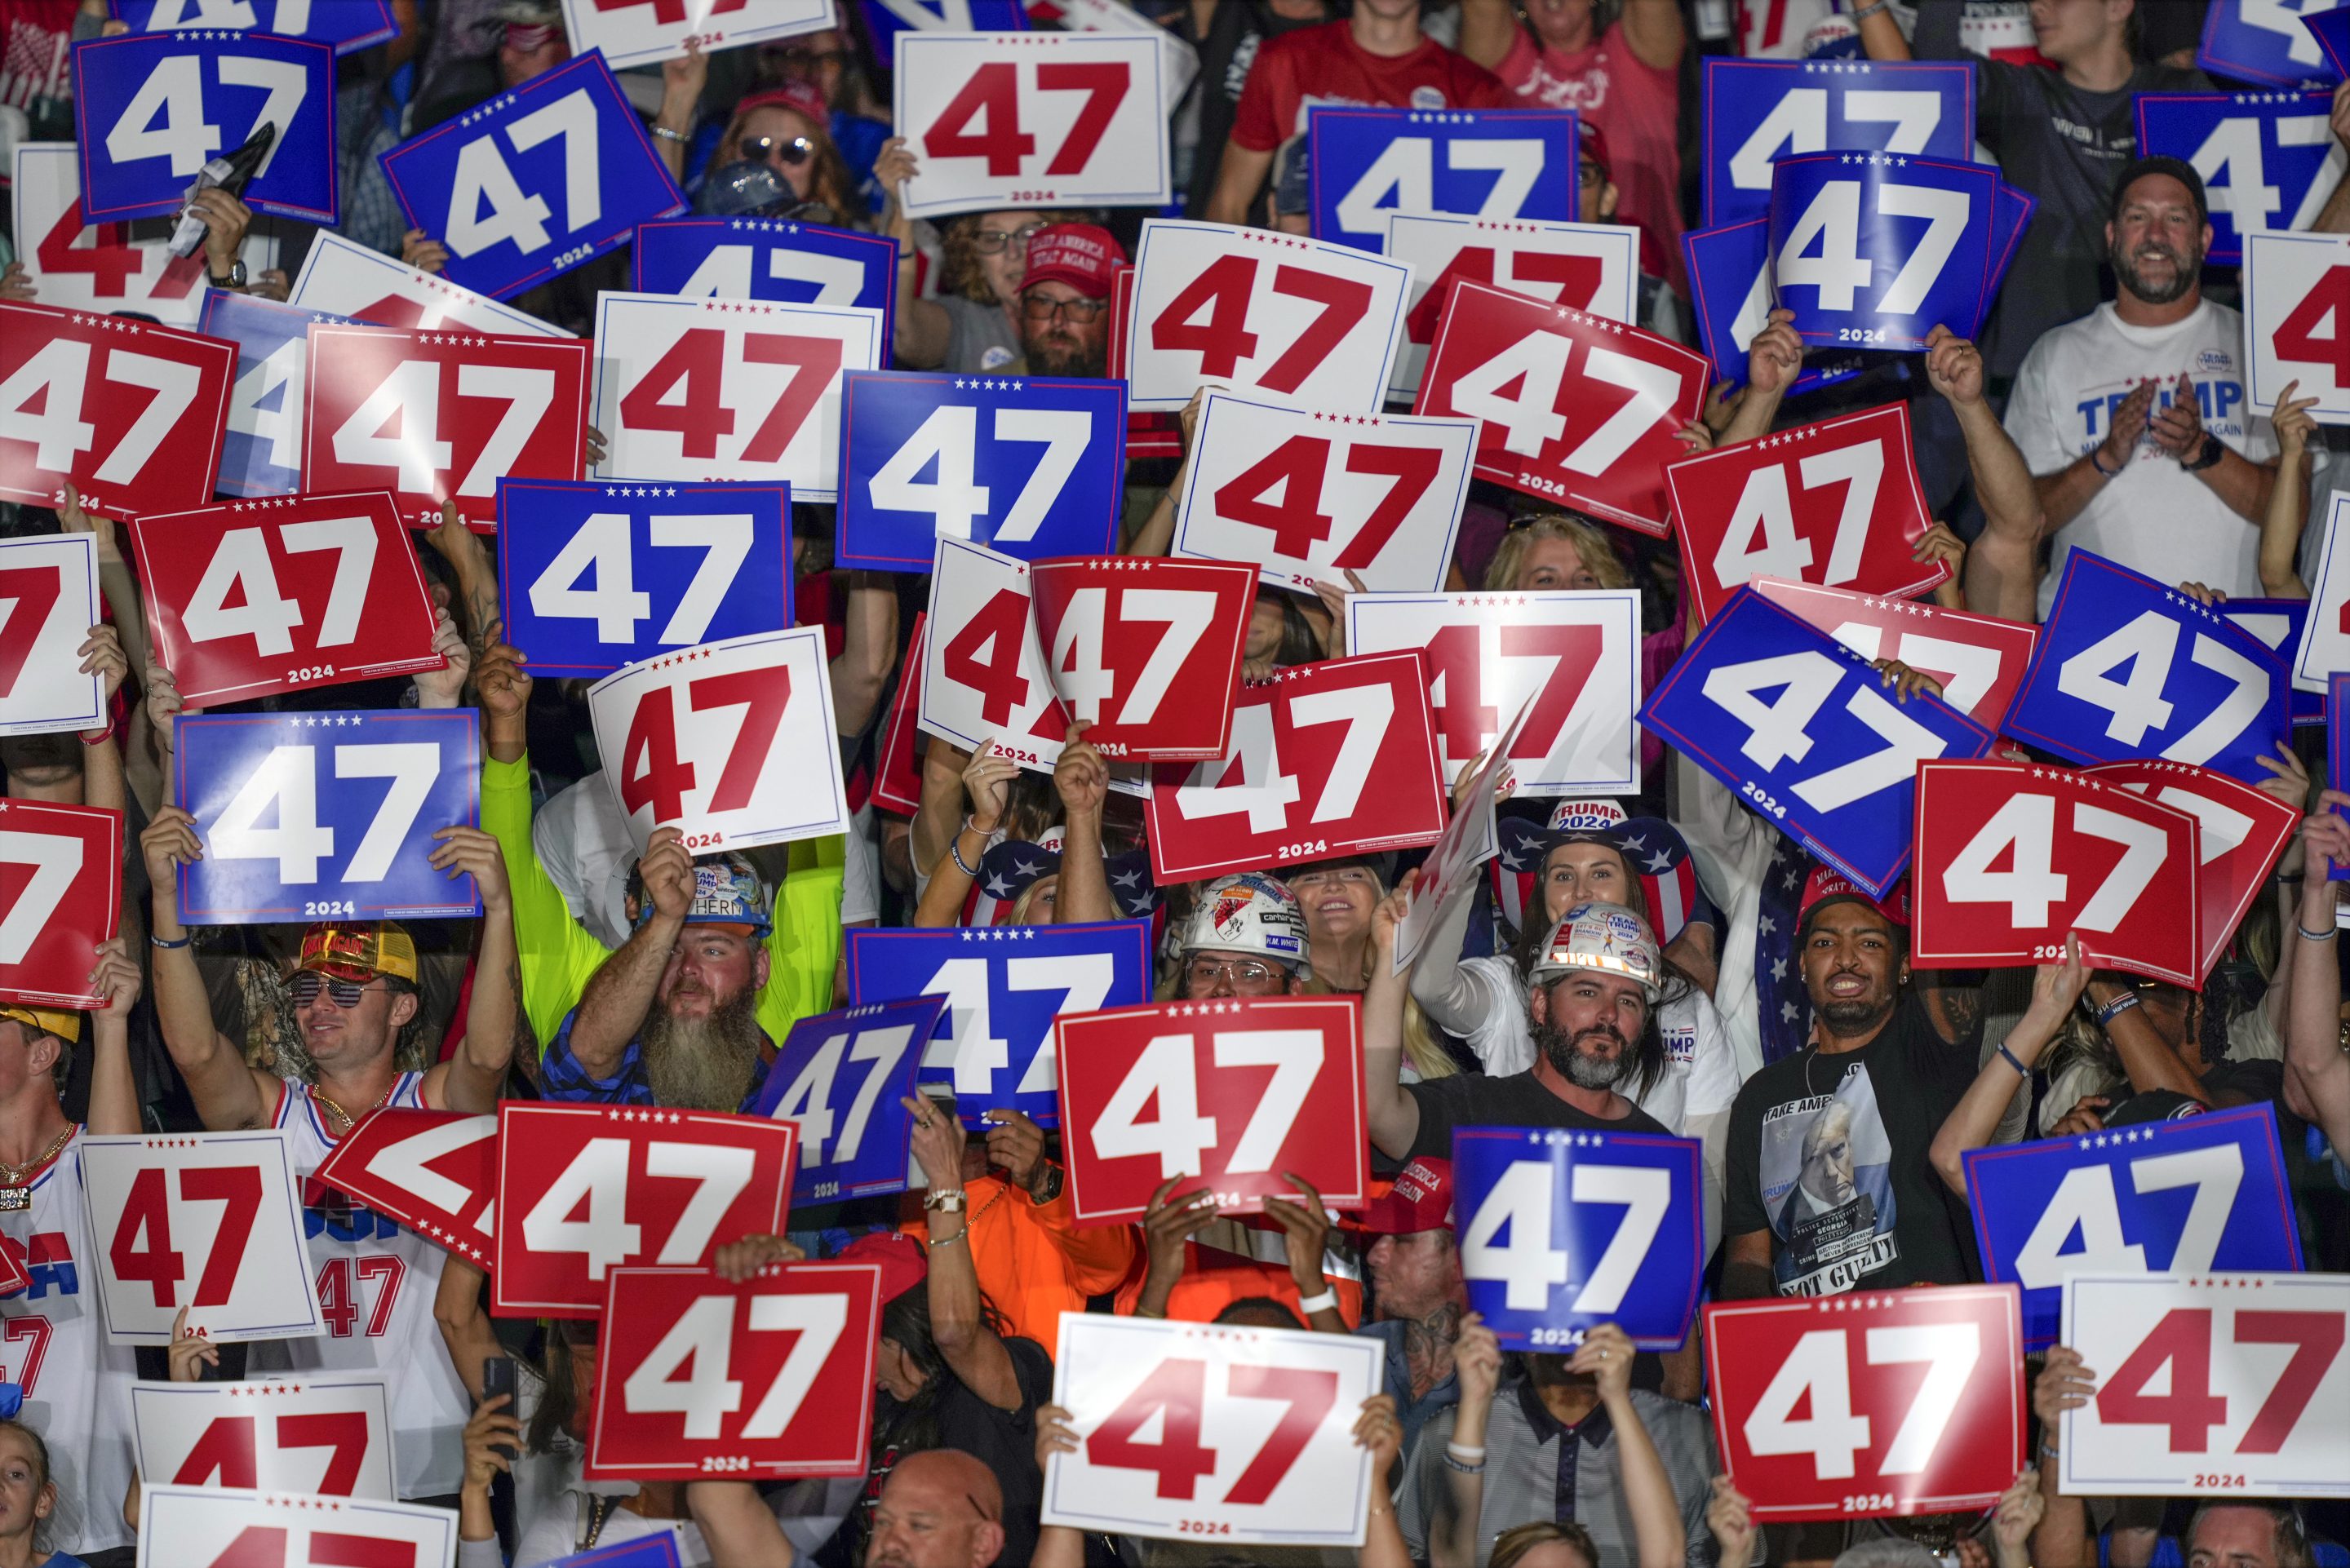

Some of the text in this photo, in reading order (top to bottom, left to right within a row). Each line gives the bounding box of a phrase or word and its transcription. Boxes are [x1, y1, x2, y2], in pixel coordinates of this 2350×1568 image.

[105, 55, 307, 178] 47
[924, 62, 1130, 177] 47
[1729, 88, 1941, 189] 47
[444, 87, 601, 259] 47
[1010, 190, 1055, 202] 2024
[1336, 137, 1545, 234] 47
[2188, 114, 2348, 233] 47
[552, 242, 594, 271] 2024
[1777, 180, 1970, 314] 47
[1151, 255, 1373, 394] 47
[1838, 328, 1886, 343] 2024
[0, 338, 202, 485] 47
[331, 360, 555, 498] 47
[620, 328, 843, 463] 47
[1451, 329, 1683, 477] 47
[54, 489, 100, 511] 224
[420, 511, 466, 526] 204
[867, 405, 1092, 542] 47
[1214, 434, 1443, 569] 47
[1518, 472, 1566, 497] 2024
[1713, 438, 1885, 588] 47
[181, 516, 379, 658] 47
[528, 513, 754, 644] 47
[1291, 574, 1314, 588] 20
[287, 665, 335, 684] 2024
[943, 587, 1066, 742] 4
[1052, 587, 1218, 724] 47
[1426, 625, 1603, 760] 47
[2057, 609, 2270, 767] 47
[621, 664, 791, 826] 47
[993, 743, 1039, 765] 2024
[1175, 682, 1394, 834] 47
[1701, 650, 1949, 813] 47
[207, 742, 440, 884] 47
[1278, 839, 1328, 859] 2024
[1553, 804, 1621, 822] TRUMP
[1558, 816, 1612, 830] 2024
[1740, 780, 1788, 820] 2024
[304, 901, 355, 915] 2024
[694, 870, 715, 880] EAM
[1942, 792, 2168, 933] 47
[1281, 939, 1298, 948] WHITE
[1608, 921, 1640, 934] TRUMP
[1612, 915, 1638, 927] TEAM
[1617, 931, 1634, 939] 2024
[2033, 945, 2082, 959] 202
[920, 953, 1115, 1094] 47
[770, 1024, 916, 1168] 47
[1090, 1030, 1324, 1180] 47
[1765, 1103, 1794, 1123] TAKE
[109, 1165, 263, 1308] 47
[523, 1137, 756, 1280] 47
[814, 1181, 839, 1198] 2024
[1460, 1159, 1671, 1314] 47
[1817, 1220, 1848, 1235] GEORGIA
[2014, 1142, 2245, 1290] 47
[316, 1255, 406, 1338] 47
[1781, 1273, 1822, 1299] NOT
[1818, 1244, 1841, 1255] ELECTION
[1824, 1250, 1842, 1258] NEVER
[184, 1327, 207, 1338] 24
[623, 1292, 849, 1440] 47
[1530, 1328, 1585, 1346] 2024
[2095, 1308, 2347, 1455] 47
[1086, 1358, 1338, 1505] 47
[1743, 1322, 1981, 1482] 47
[701, 1457, 750, 1472] 2024
[1843, 1495, 1894, 1511] 2024
[2194, 1474, 2247, 1489] 2024
[1177, 1520, 1231, 1535] 2024
